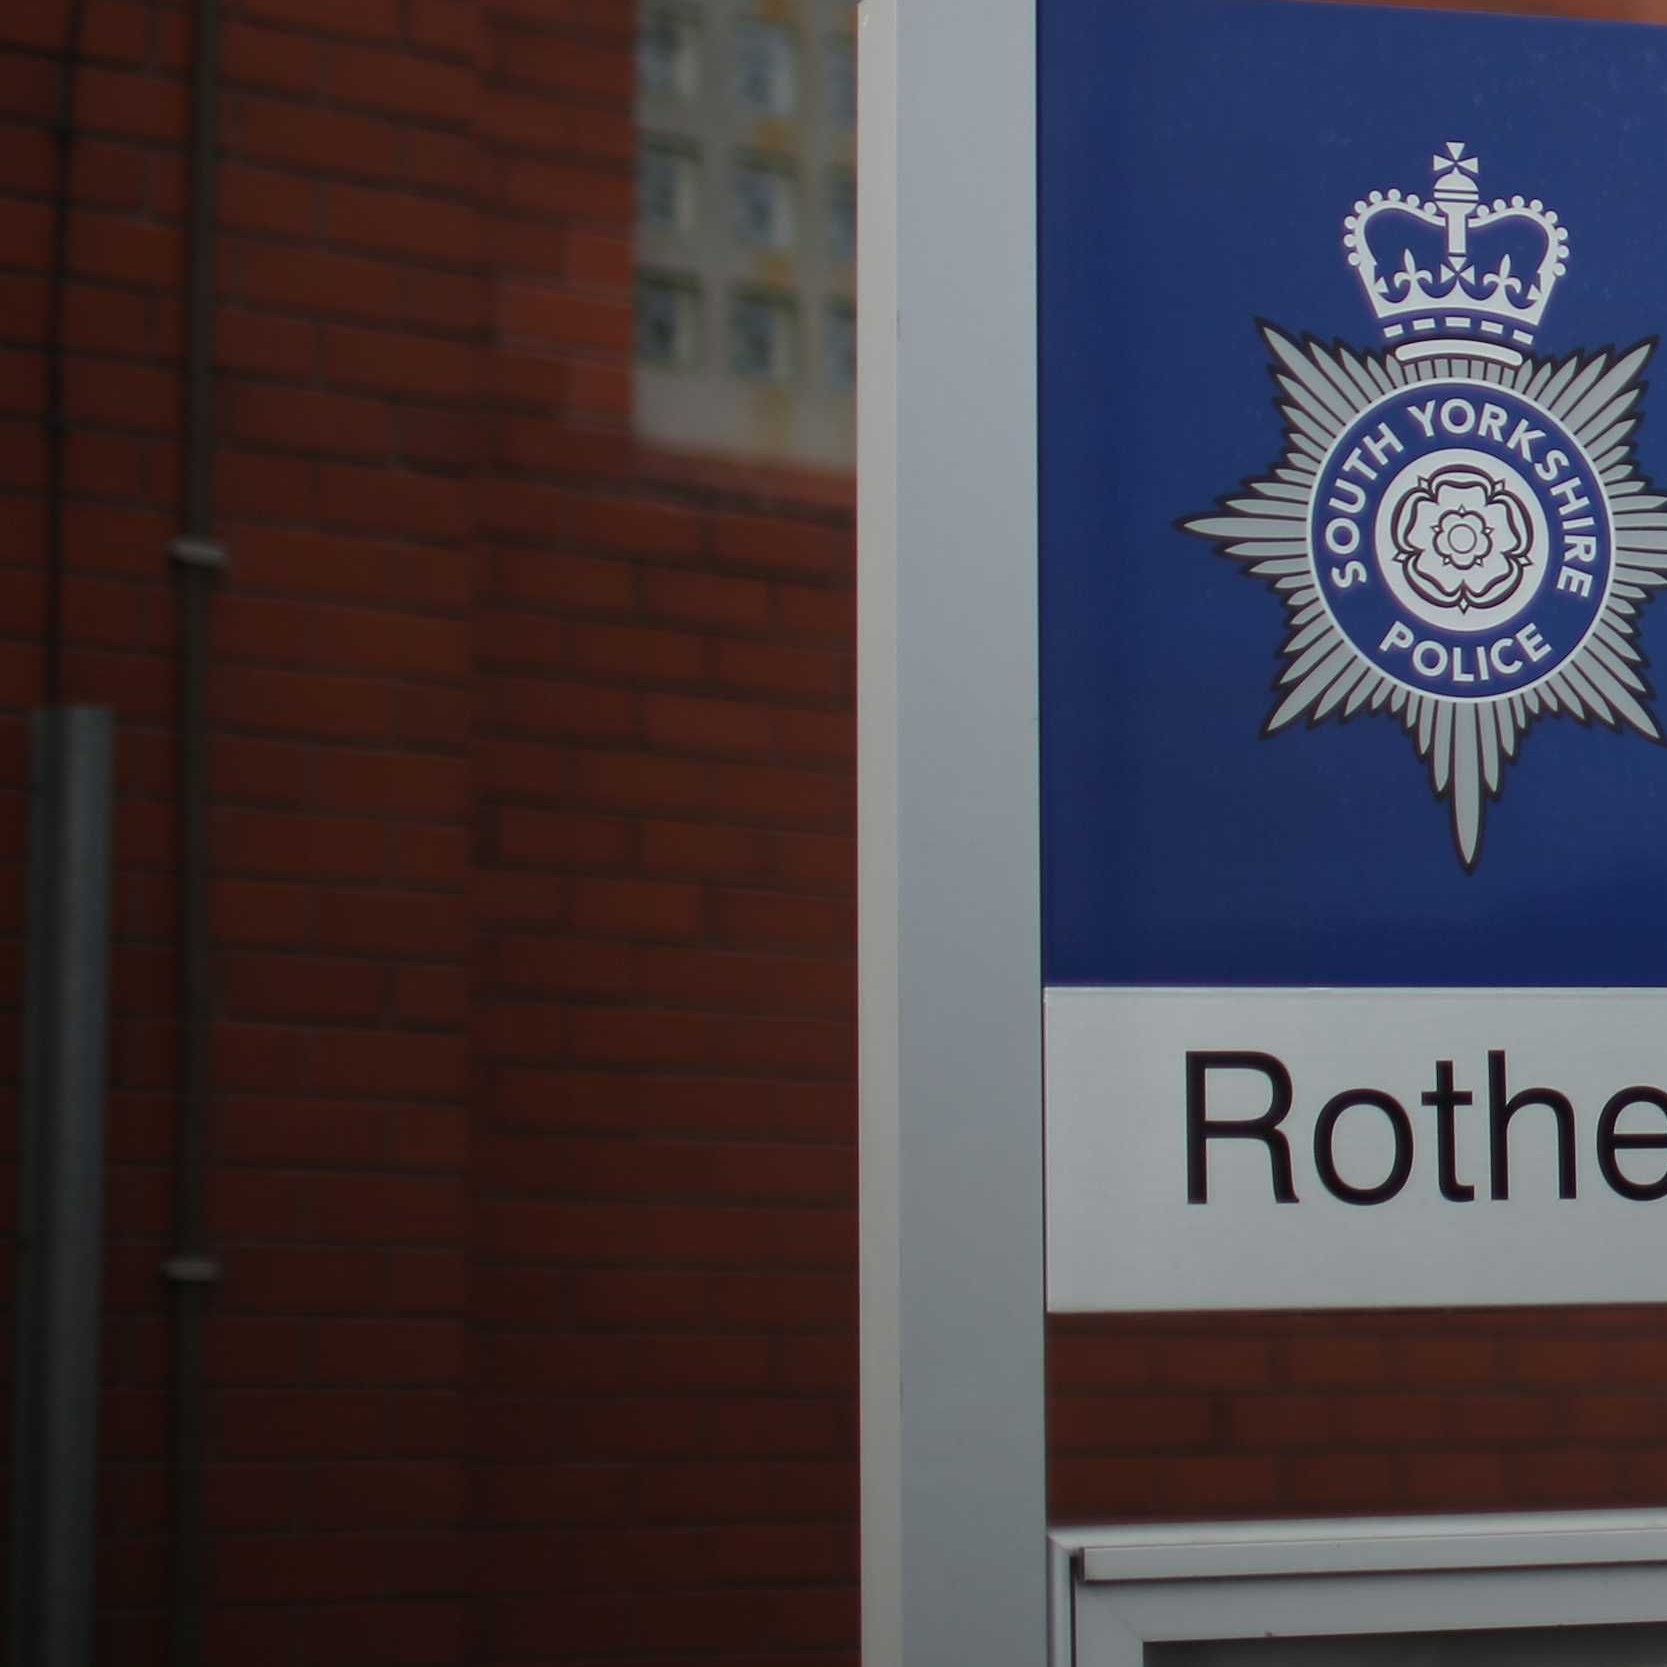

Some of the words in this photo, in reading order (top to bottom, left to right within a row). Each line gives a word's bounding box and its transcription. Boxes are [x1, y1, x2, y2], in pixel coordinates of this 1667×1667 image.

[1324, 421, 1405, 589] SOUTH
[1407, 397, 1599, 600] YORKSHIRE
[1379, 620, 1554, 683] POLICE
